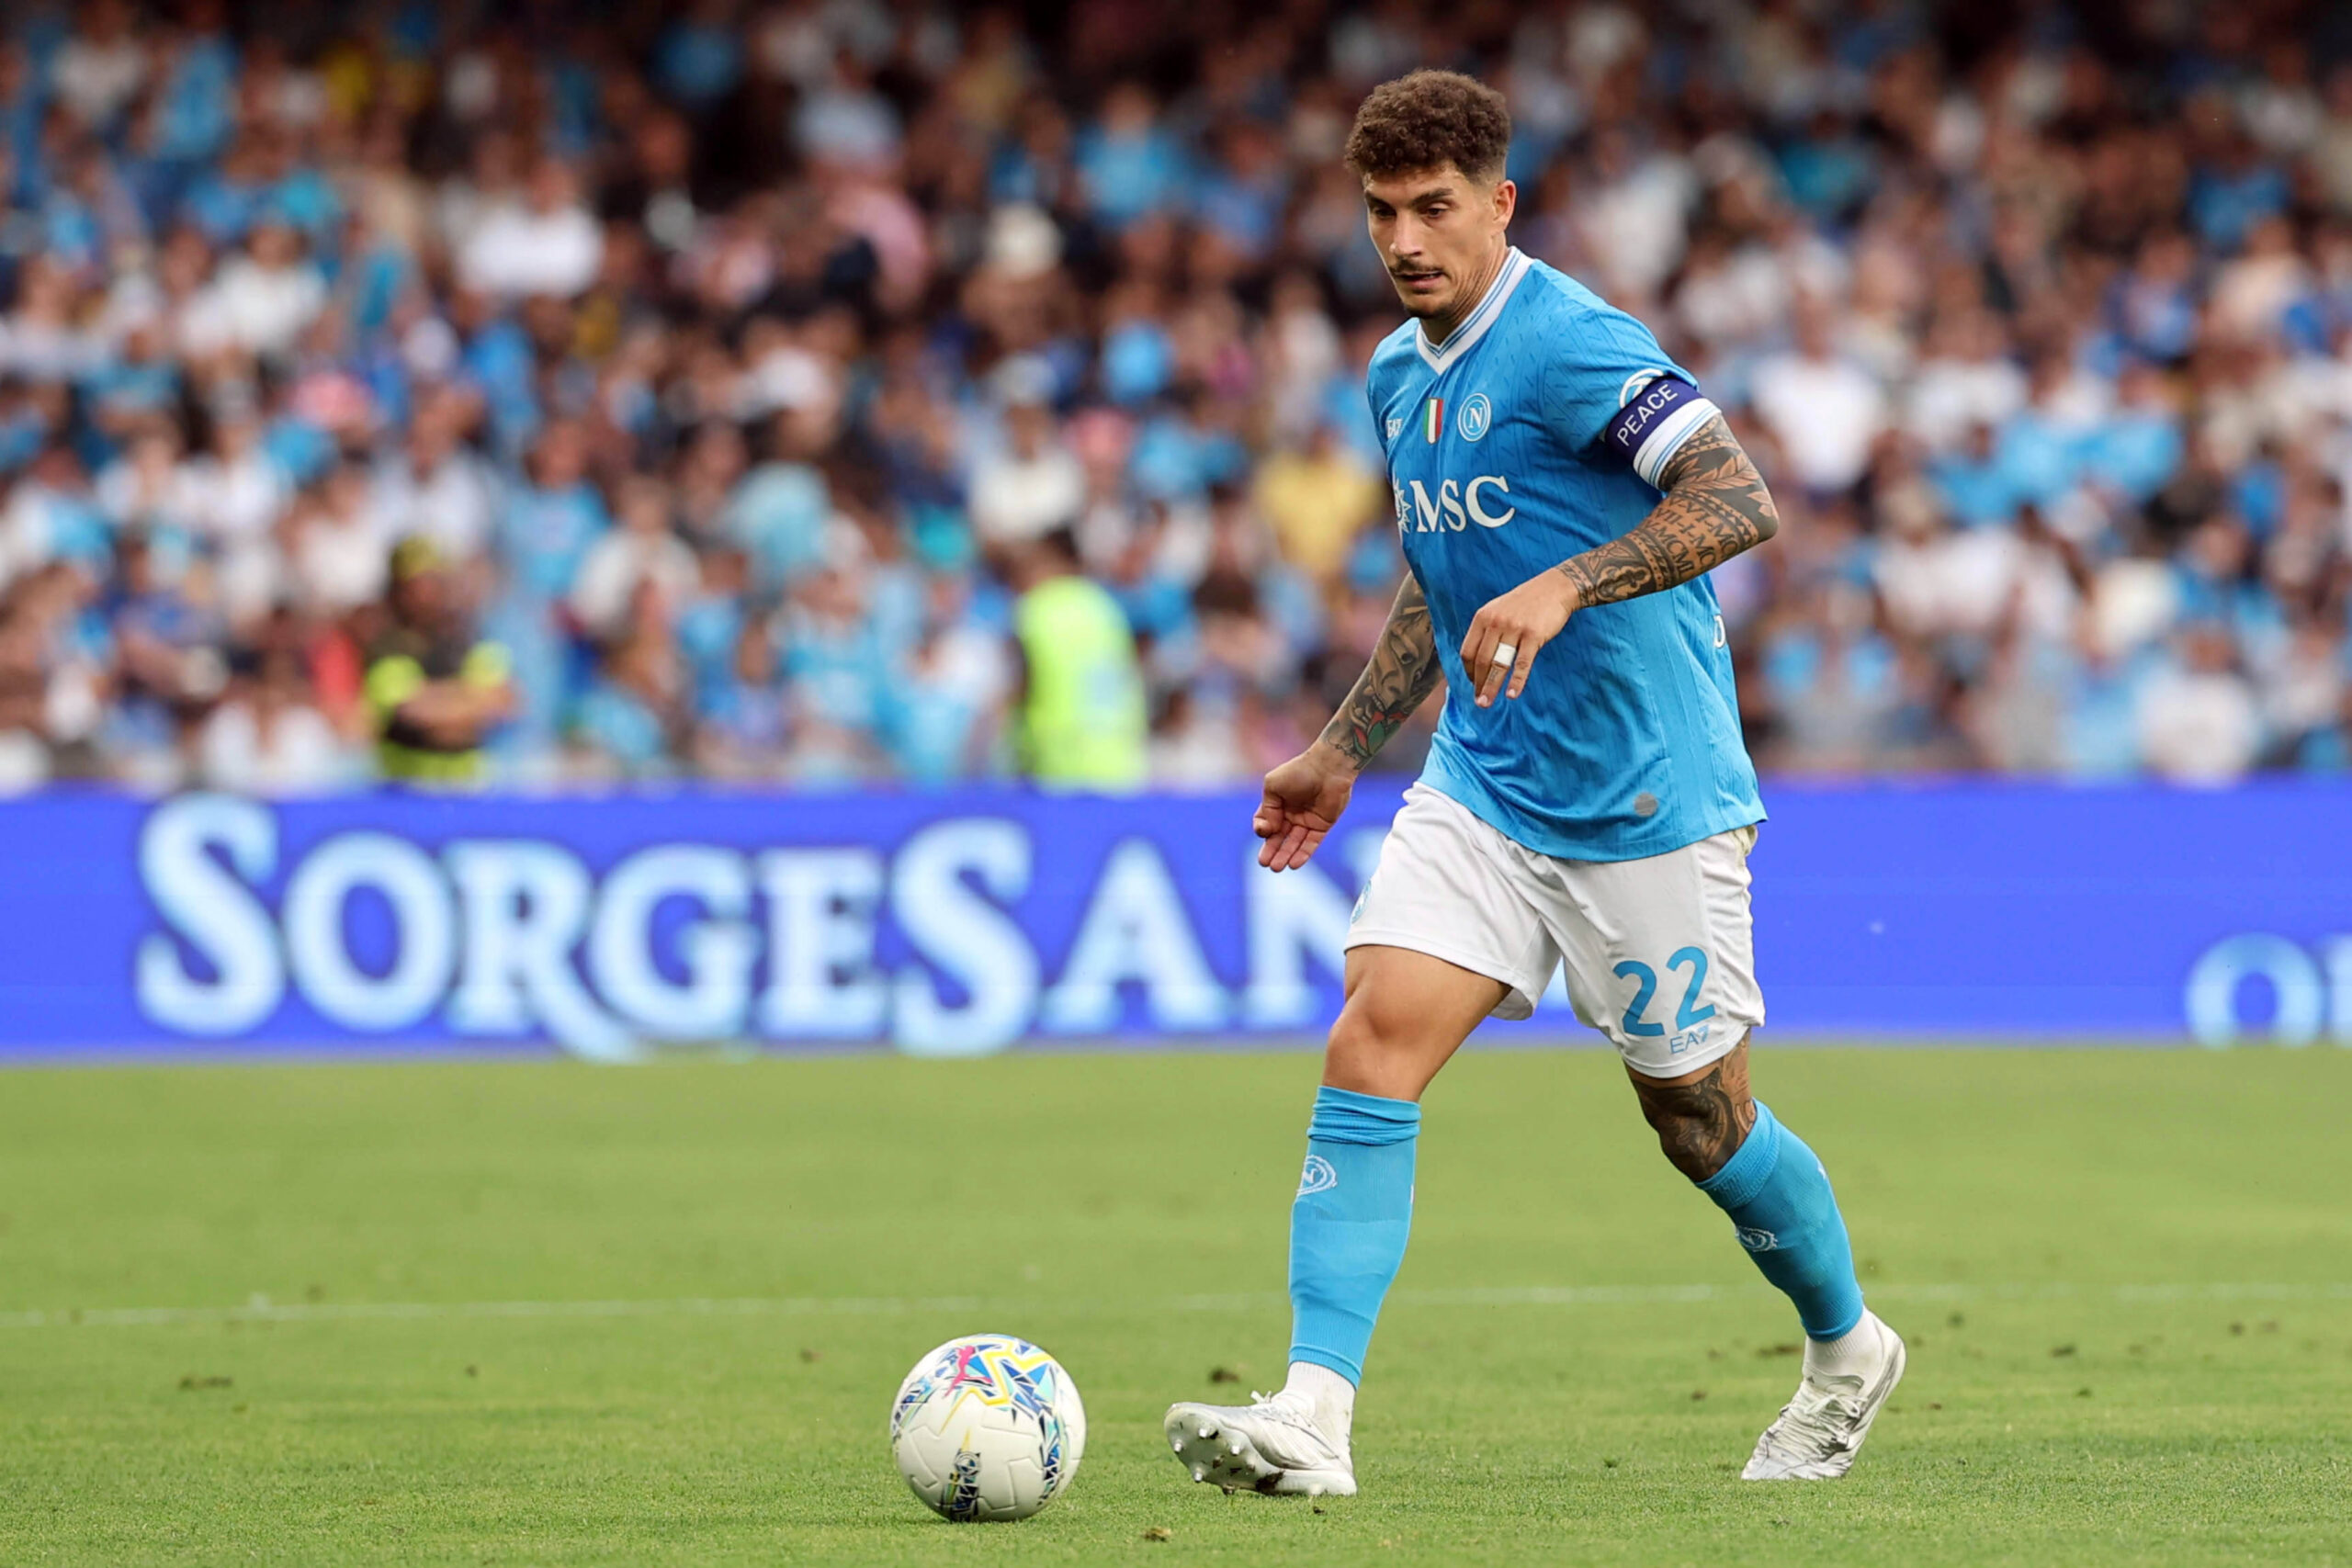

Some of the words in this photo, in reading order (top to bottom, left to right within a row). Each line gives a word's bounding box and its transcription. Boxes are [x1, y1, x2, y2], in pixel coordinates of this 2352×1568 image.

[1617, 384, 1678, 446] PEACE
[1409, 476, 1515, 533] MSC
[136, 792, 1568, 1063] SORGESAN
[1612, 946, 1715, 1037] 22
[1670, 1025, 1710, 1055] EA7
